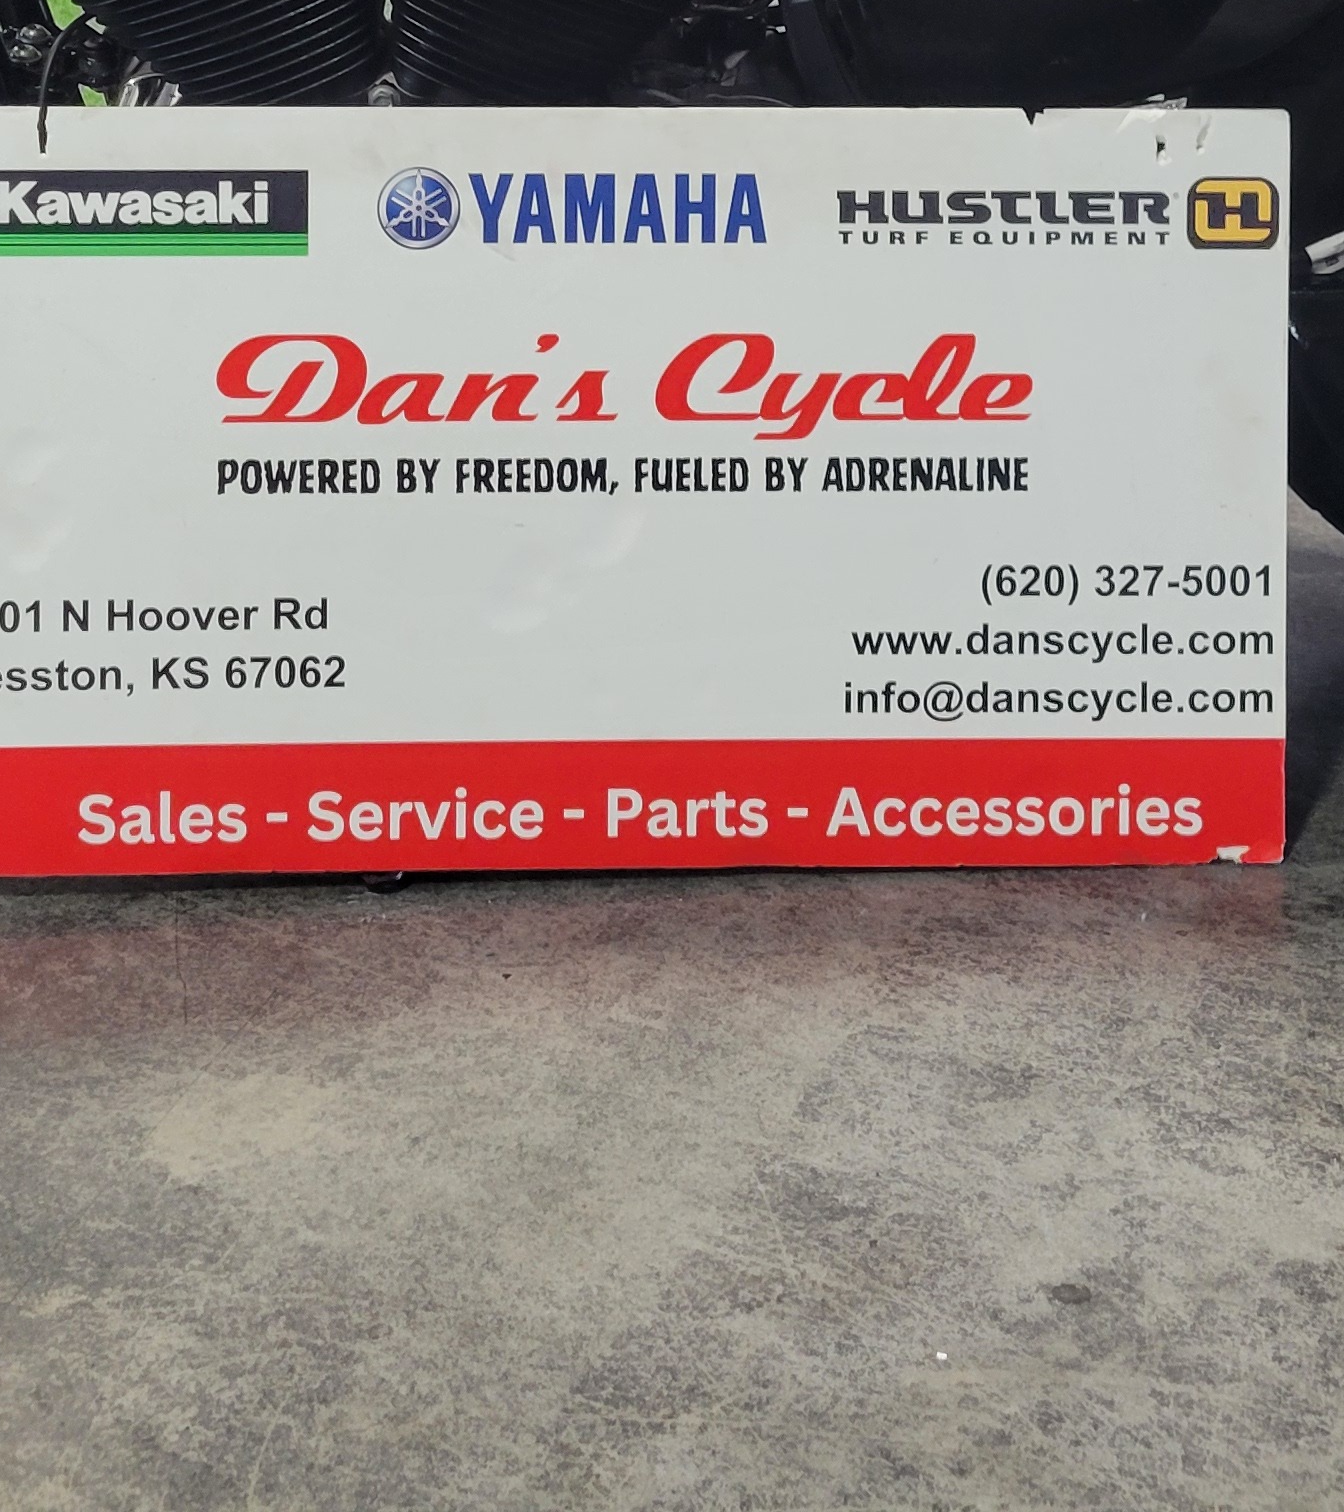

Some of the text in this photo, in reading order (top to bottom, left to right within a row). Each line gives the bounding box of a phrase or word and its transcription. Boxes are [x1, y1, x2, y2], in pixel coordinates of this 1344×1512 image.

[468, 173, 767, 244] YAMAHA
[836, 190, 1170, 225] HUSTLER
[839, 231, 1170, 245] TURF EQUIPMENT
[216, 333, 1033, 441] Dan's Cycle
[217, 456, 1029, 496] POWERED BY FREEDOM, FUELED BY ADRENALINE
[981, 564, 1270, 606] (620) 327-5001
[62, 599, 89, 632] N
[107, 598, 259, 632] Hoover
[274, 597, 329, 630] Rd
[851, 623, 1274, 664] www.danscycle.com
[152, 657, 209, 690] KS
[225, 655, 347, 689] 67062
[844, 681, 1274, 722] info@danscycle.com
[78, 790, 248, 844] Sales
[307, 786, 544, 841] Service
[607, 787, 769, 838] Parts
[826, 783, 1204, 837] Accessories
